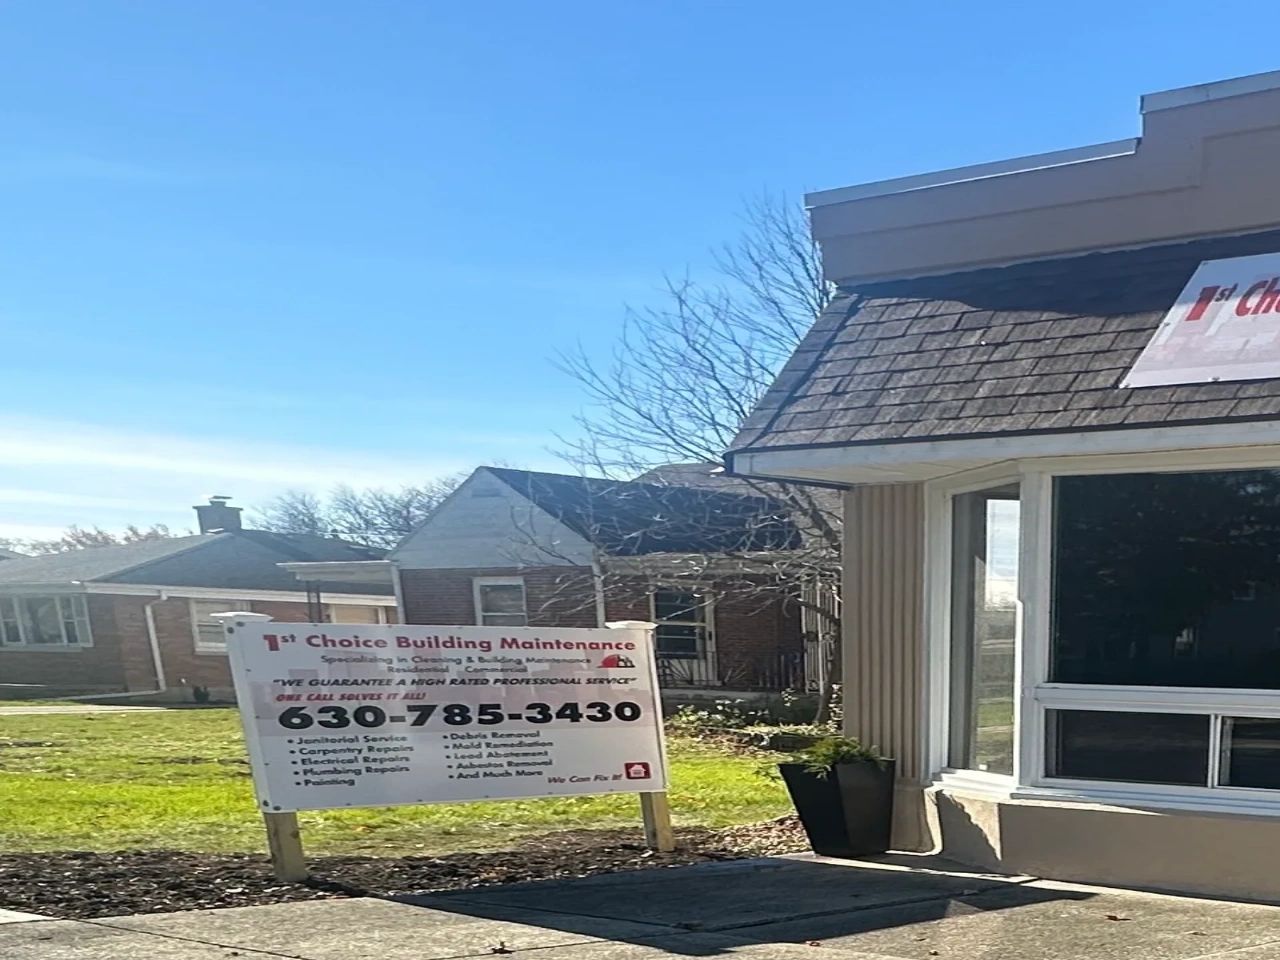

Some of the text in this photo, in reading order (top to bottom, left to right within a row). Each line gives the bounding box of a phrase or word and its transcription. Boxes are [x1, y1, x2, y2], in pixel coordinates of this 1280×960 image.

[1185, 283, 1238, 321] 1st
[263, 634, 635, 651] 1st Choice Building Maintenance
[321, 655, 393, 664] Specializing
[411, 656, 461, 665] Cleaning
[477, 656, 522, 665] Building
[525, 656, 592, 664] Maintenance
[411, 678, 445, 686] HIGH
[306, 693, 333, 701] CALL
[402, 692, 427, 700] ALL!
[278, 702, 641, 729] 630-785-3430
[296, 735, 407, 744] Janitorial Service
[450, 731, 540, 740] Debris Removal
[299, 745, 414, 756] Carpentry Repairs
[452, 741, 553, 750] Mold Remediation
[486, 750, 548, 759] Abatement
[301, 755, 410, 765] Electrical Repairs
[456, 759, 552, 769] Asbestos Removal
[303, 765, 410, 776] Plumbing Repairs
[516, 769, 543, 777] More
[304, 778, 355, 786] Painting
[547, 776, 565, 784] We
[570, 775, 591, 783] Can
[594, 774, 609, 782] Fix
